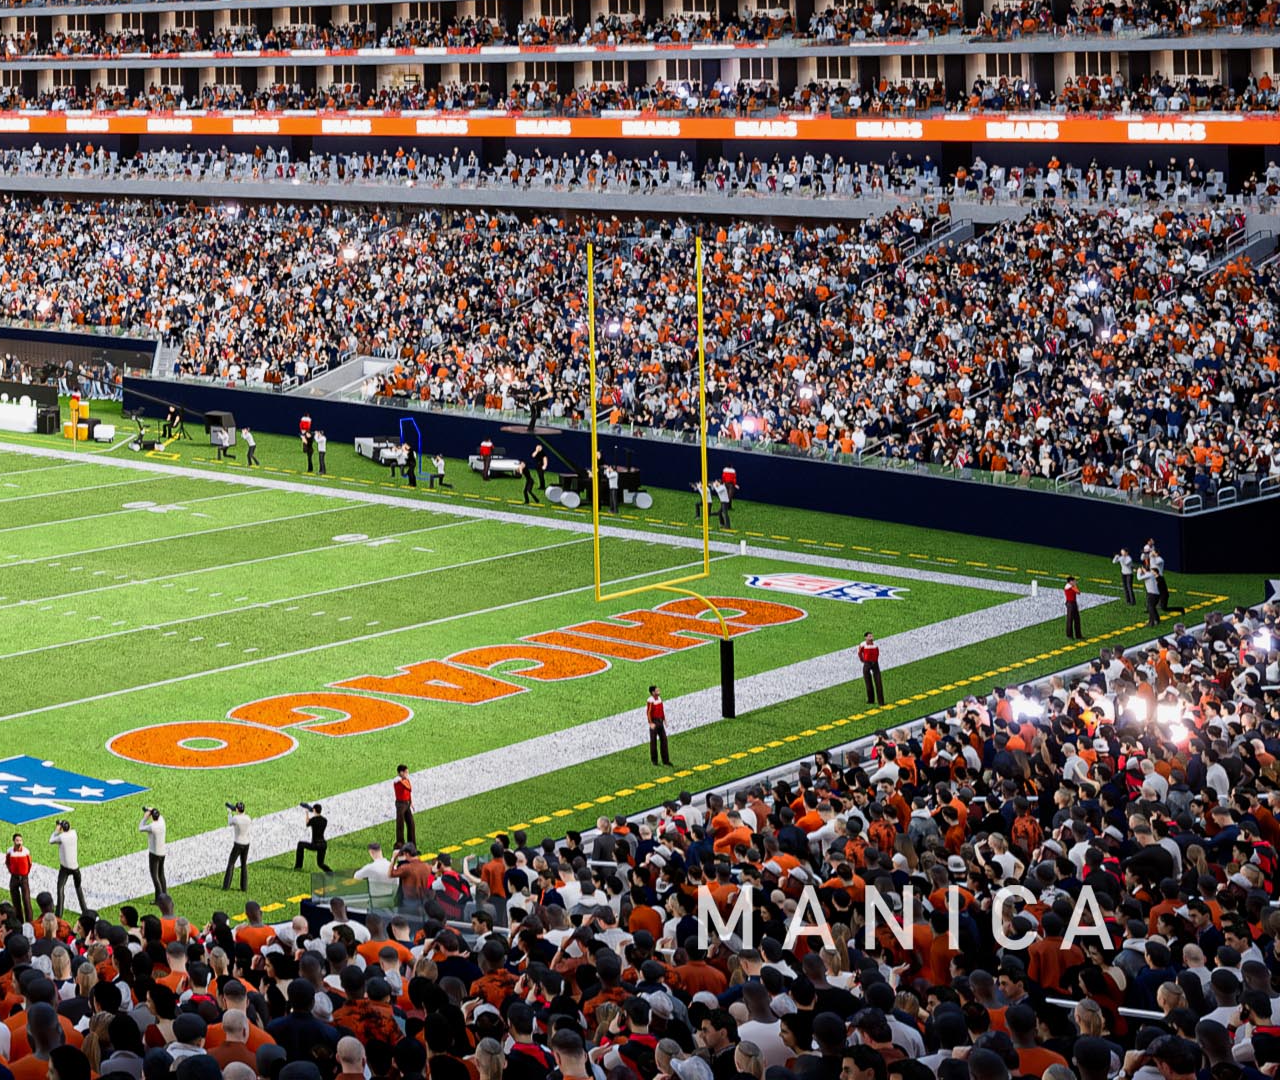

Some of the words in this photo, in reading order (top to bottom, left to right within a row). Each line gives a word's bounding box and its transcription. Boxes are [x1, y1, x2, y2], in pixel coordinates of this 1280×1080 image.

[735, 121, 797, 137] BEARS
[856, 121, 923, 138] BEARS
[986, 122, 1059, 139] BEARS
[1128, 123, 1206, 141] BEARS
[104, 595, 809, 770] CHICAGO
